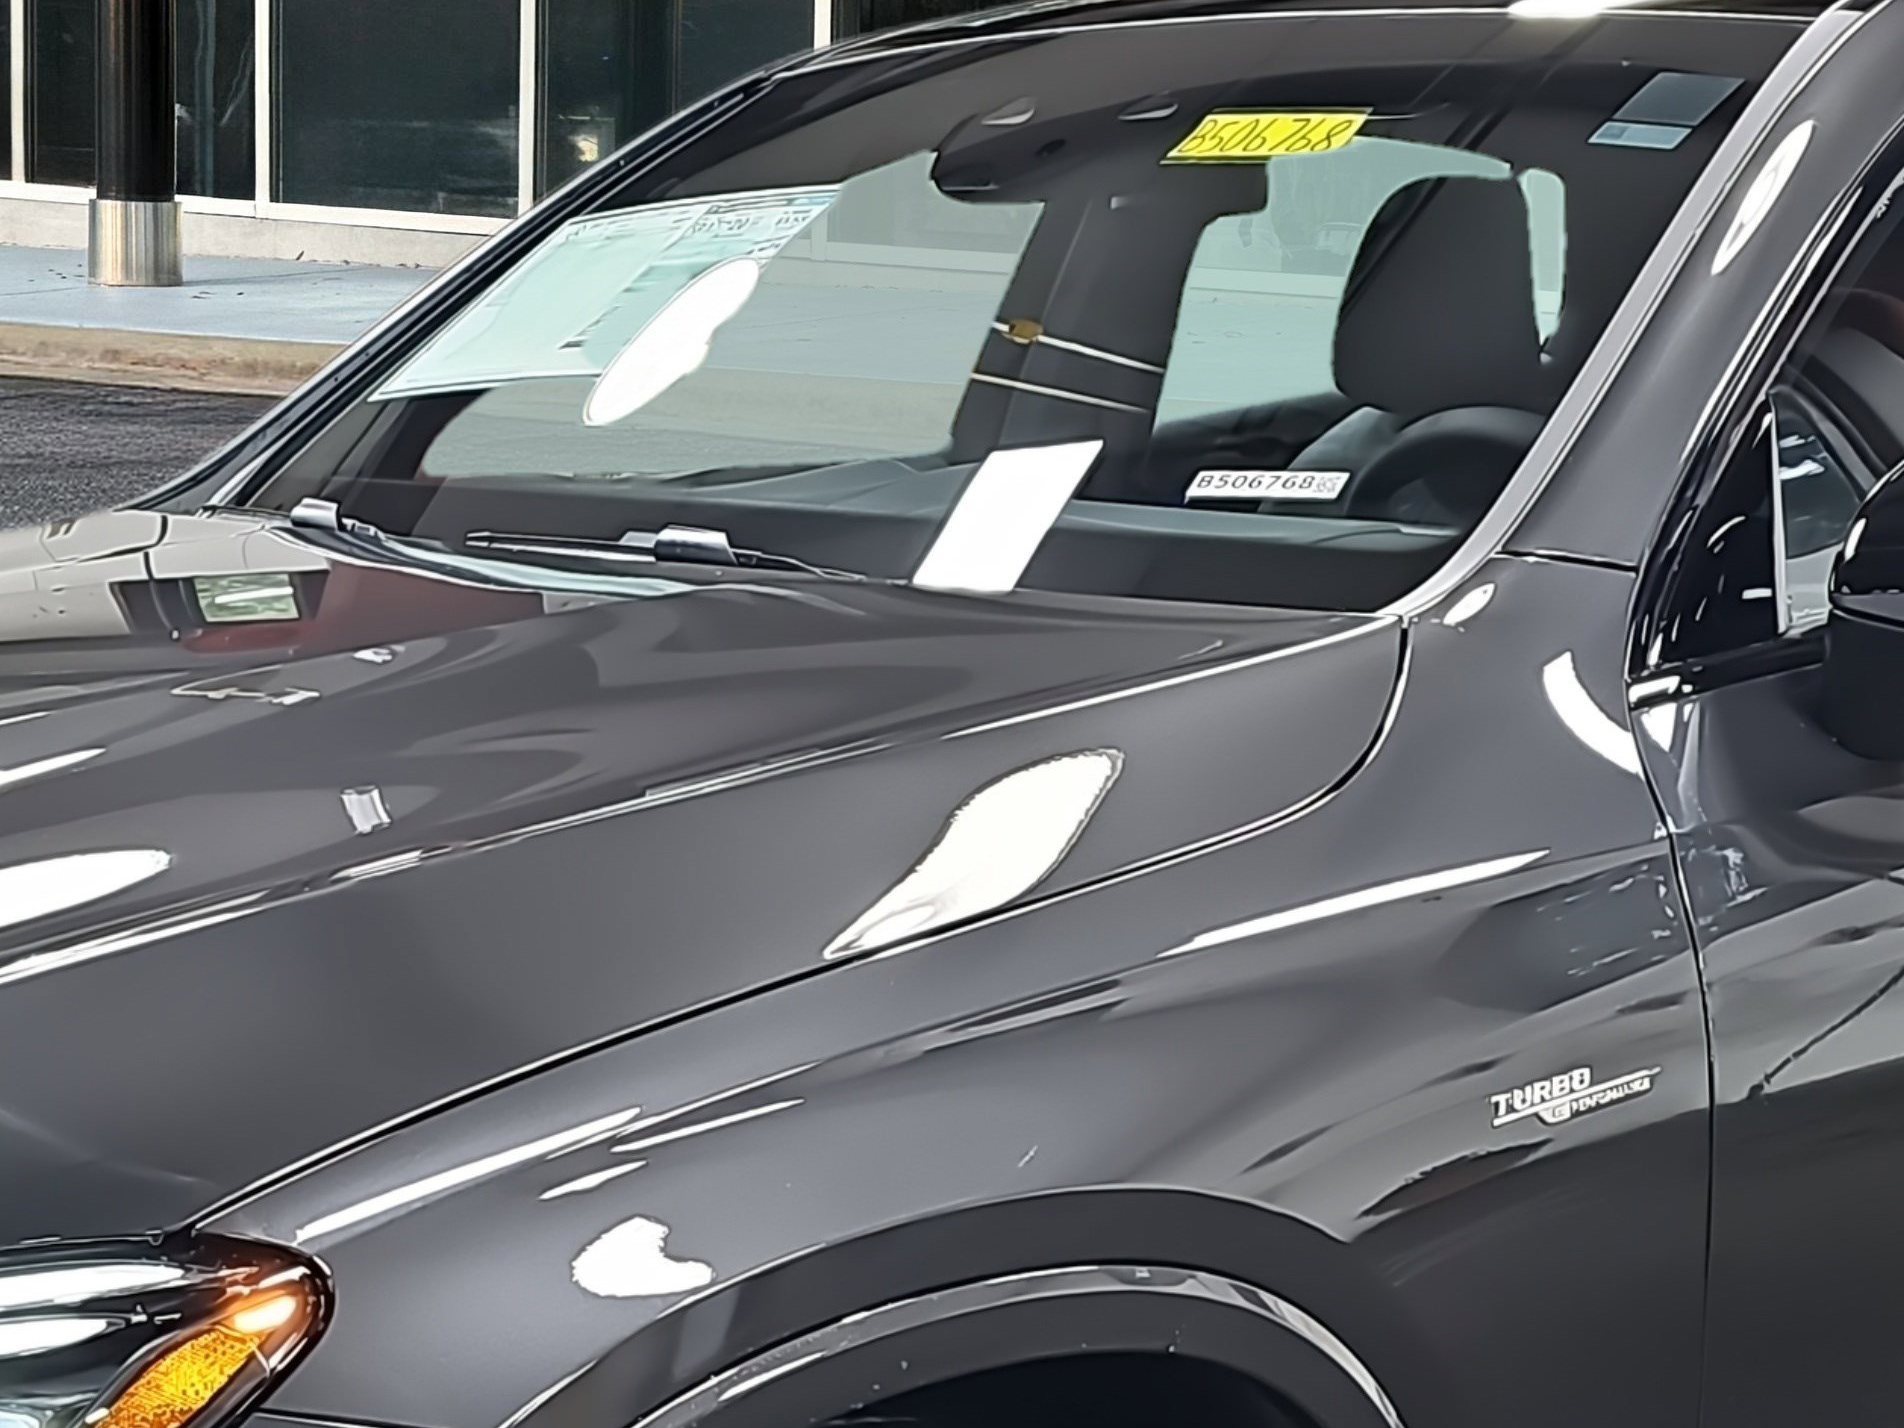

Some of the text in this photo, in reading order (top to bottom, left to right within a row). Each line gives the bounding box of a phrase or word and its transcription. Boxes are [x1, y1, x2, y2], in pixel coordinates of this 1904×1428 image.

[1178, 118, 1354, 154] B506768
[1197, 474, 1316, 490] B506768
[1490, 1066, 1592, 1117] TURBO
